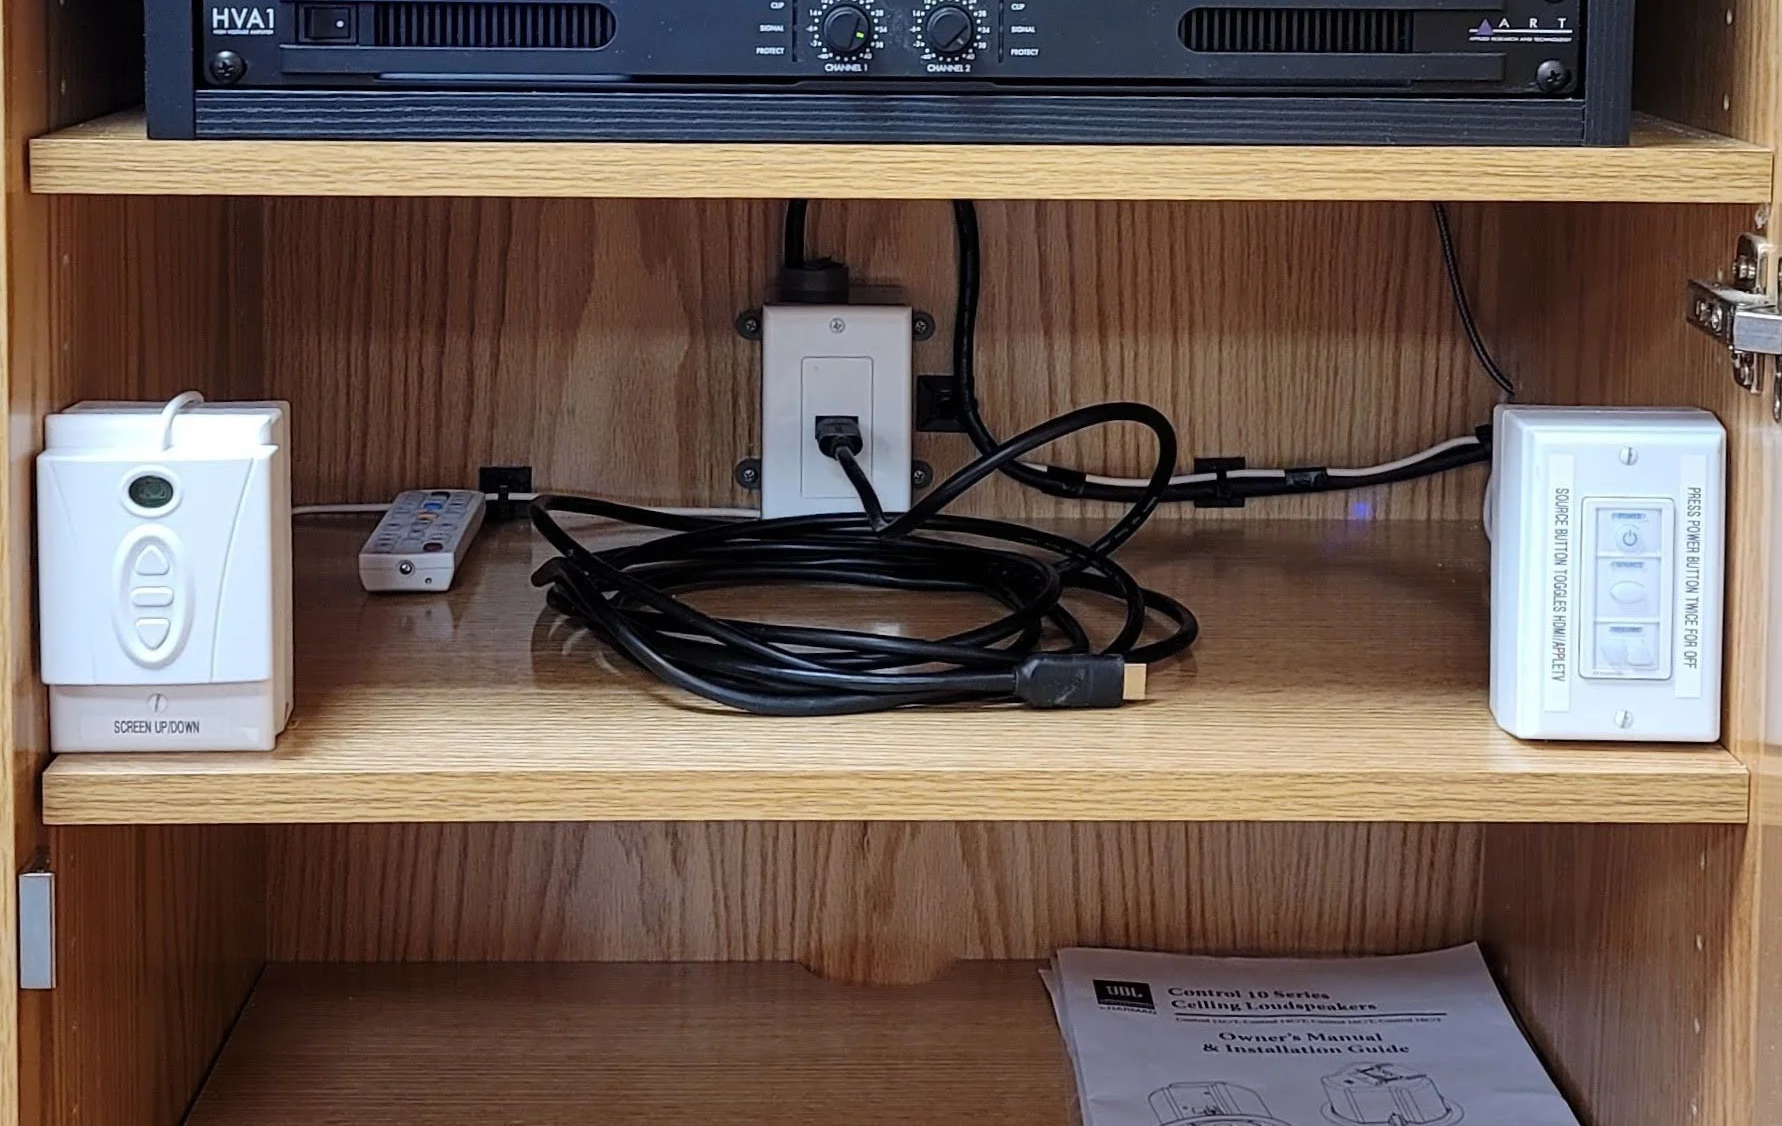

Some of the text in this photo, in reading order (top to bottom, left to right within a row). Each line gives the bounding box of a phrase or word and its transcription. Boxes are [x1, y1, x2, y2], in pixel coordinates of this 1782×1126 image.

[1011, 3, 1025, 11] CLIP
[212, 7, 275, 29] HVA1
[1011, 26, 1035, 34] SIGNAL
[1011, 48, 1039, 56] PROTECT
[824, 63, 862, 72] CHANNEL
[927, 64, 971, 72] CHANNEL 2
[1683, 487, 1702, 669] PRESS POWER BUTTON TWICE FOR OFF
[1551, 488, 1570, 682] SOURCE BUTTON TOGGLES HDMI/APPLETV
[114, 720, 200, 734] SCREEN UP/DOWN
[1167, 987, 1331, 1000] Control 10 Series
[1171, 1000, 1377, 1012] Ceiling Loudspeakers
[1219, 1032, 1383, 1042] Owner's Manual
[1203, 1043, 1410, 1054] & Installation Guide
